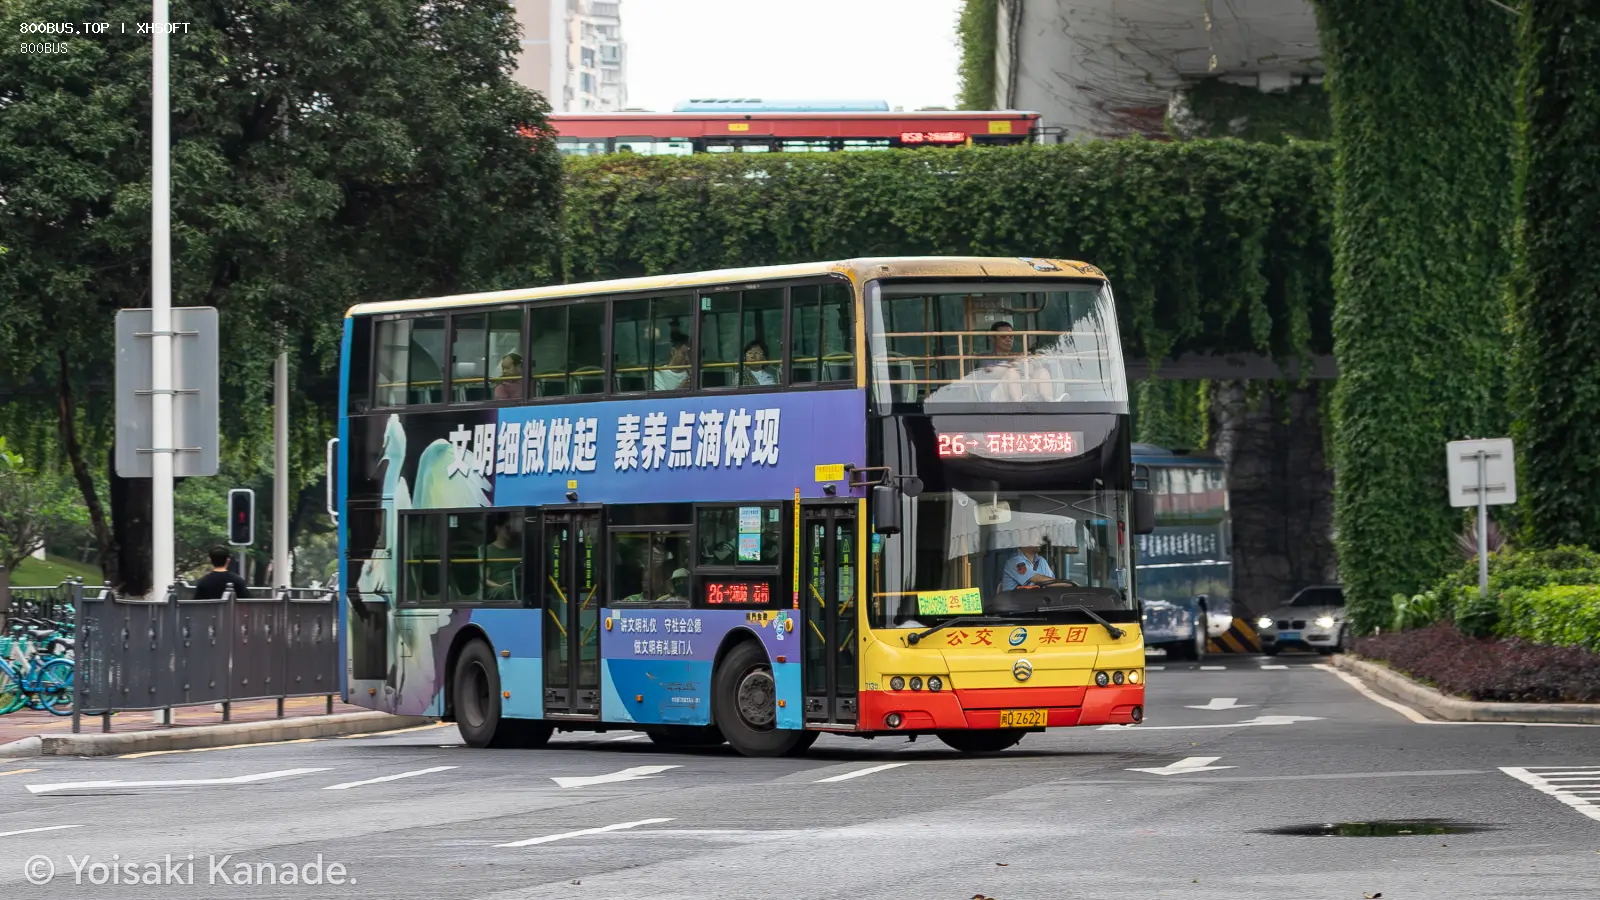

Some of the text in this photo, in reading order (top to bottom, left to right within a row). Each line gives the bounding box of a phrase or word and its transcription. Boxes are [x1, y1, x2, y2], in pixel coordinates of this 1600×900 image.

[447, 408, 781, 478] 文明细微做起 素养点滴体现
[938, 432, 1072, 455] 26 石村公交场站
[708, 583, 724, 603] 26
[949, 595, 960, 604] 26
[620, 617, 702, 633] 讲文明礼仪 守社会公德
[946, 627, 1089, 646] 公交 集团
[633, 640, 693, 656] 做文明有礼厦门人
